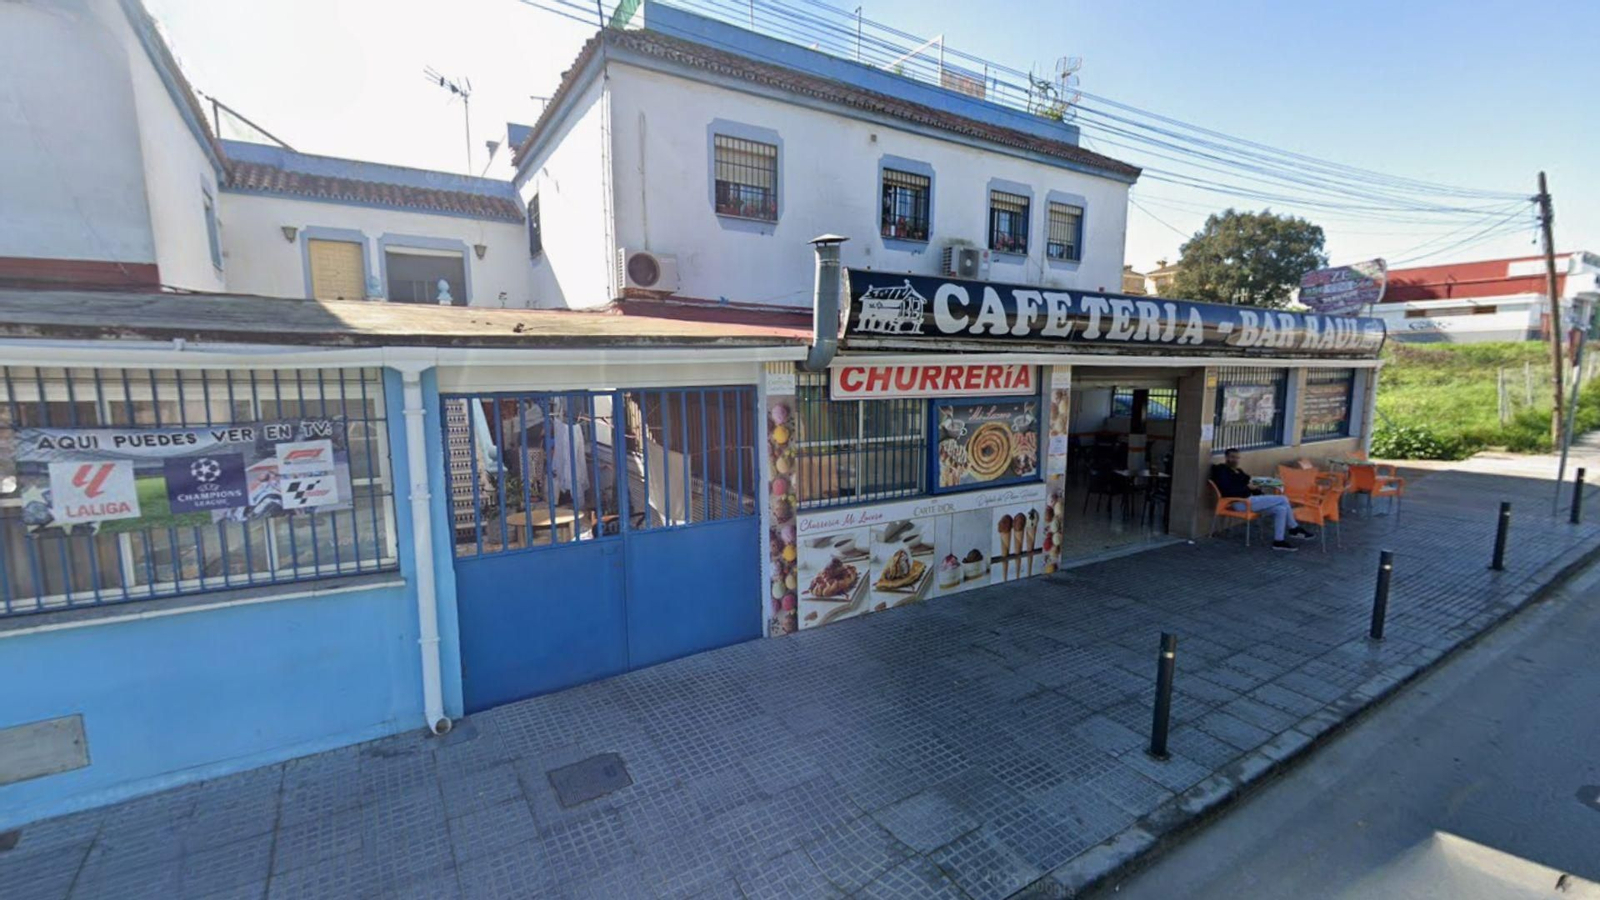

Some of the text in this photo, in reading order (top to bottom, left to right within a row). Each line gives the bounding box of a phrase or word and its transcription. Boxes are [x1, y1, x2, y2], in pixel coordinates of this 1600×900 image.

[933, 282, 1205, 346] CAFETERIA
[1236, 310, 1296, 348] BAR
[1302, 314, 1362, 350] RAUL
[37, 421, 334, 451] AQUI PUEDES VER EN TV:
[177, 489, 242, 503] CHAMPIONS
[66, 501, 131, 518] LALIGA
